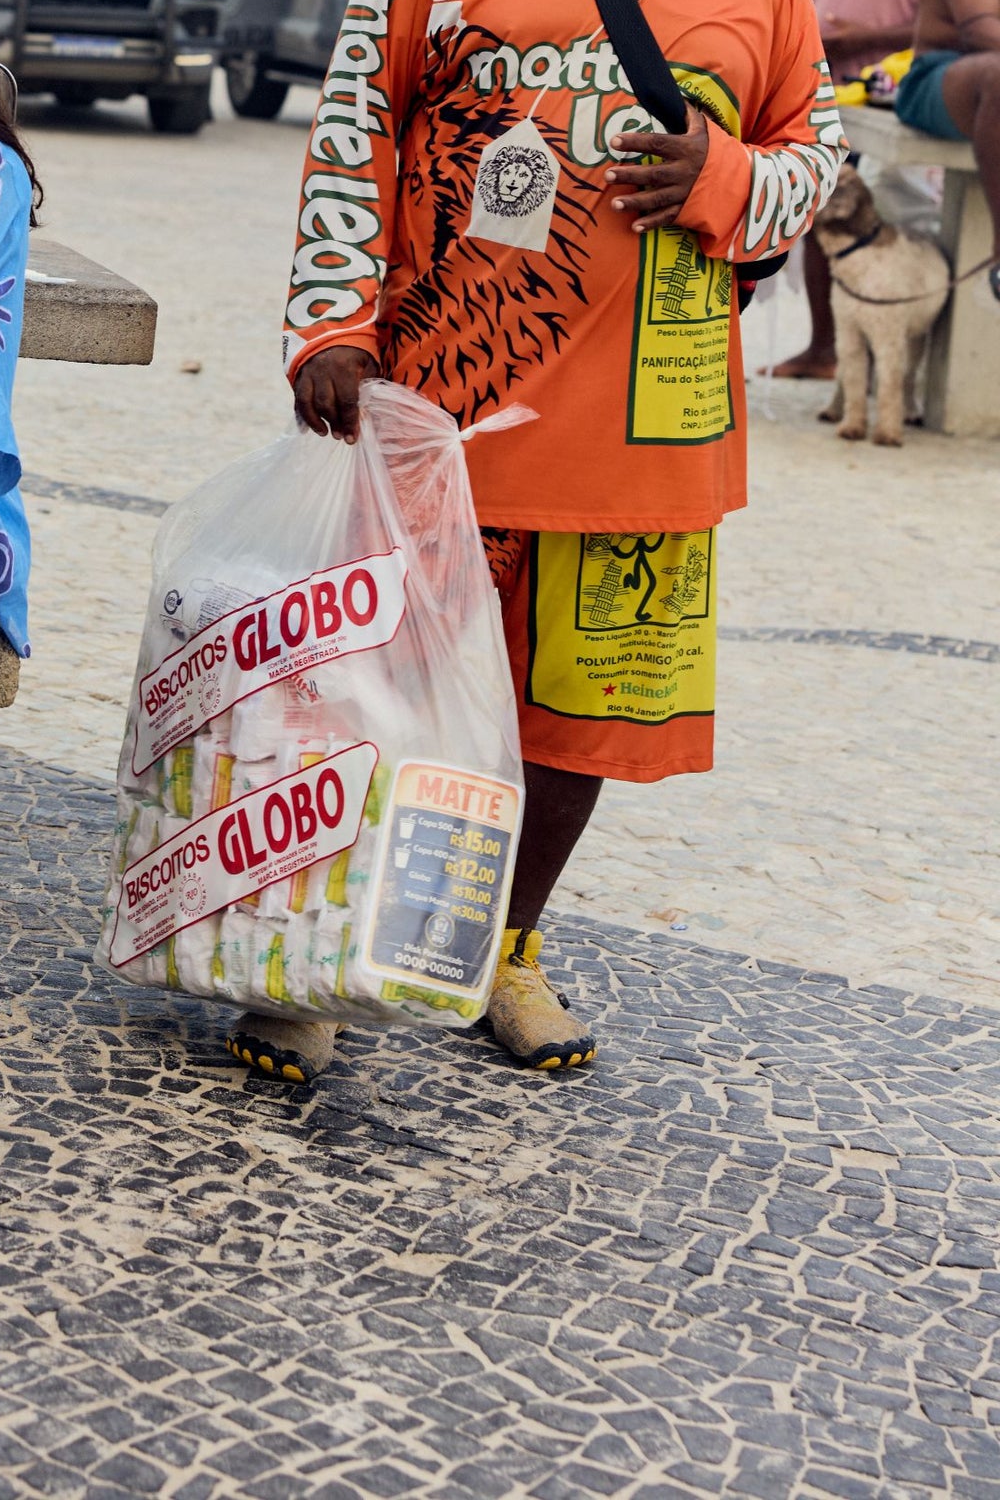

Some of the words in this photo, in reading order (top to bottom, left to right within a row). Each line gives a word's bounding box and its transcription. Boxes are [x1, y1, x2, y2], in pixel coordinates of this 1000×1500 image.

[467, 37, 632, 92] matt
[657, 329, 678, 337] Peso
[657, 374, 677, 383] Rua
[679, 374, 692, 383] do
[683, 407, 699, 416] Rio
[144, 634, 228, 717] BISCOITOS
[232, 567, 379, 672] GLOBO
[585, 634, 605, 642] Peso
[268, 663, 294, 680] MARCA
[294, 646, 340, 669] REGISTRADA
[576, 652, 633, 667] POLVILHO
[635, 652, 672, 666] AMIGO
[685, 645, 704, 657] cal.
[587, 668, 629, 680] Consumir
[630, 668, 667, 681] somente
[607, 703, 622, 713] Rio
[624, 704, 634, 713] de
[416, 773, 504, 821] MATTE
[125, 834, 211, 909] BISCOITOS
[217, 767, 345, 875] GLOBO
[257, 869, 278, 885] MARCA
[279, 851, 316, 874] REGISTRADA
